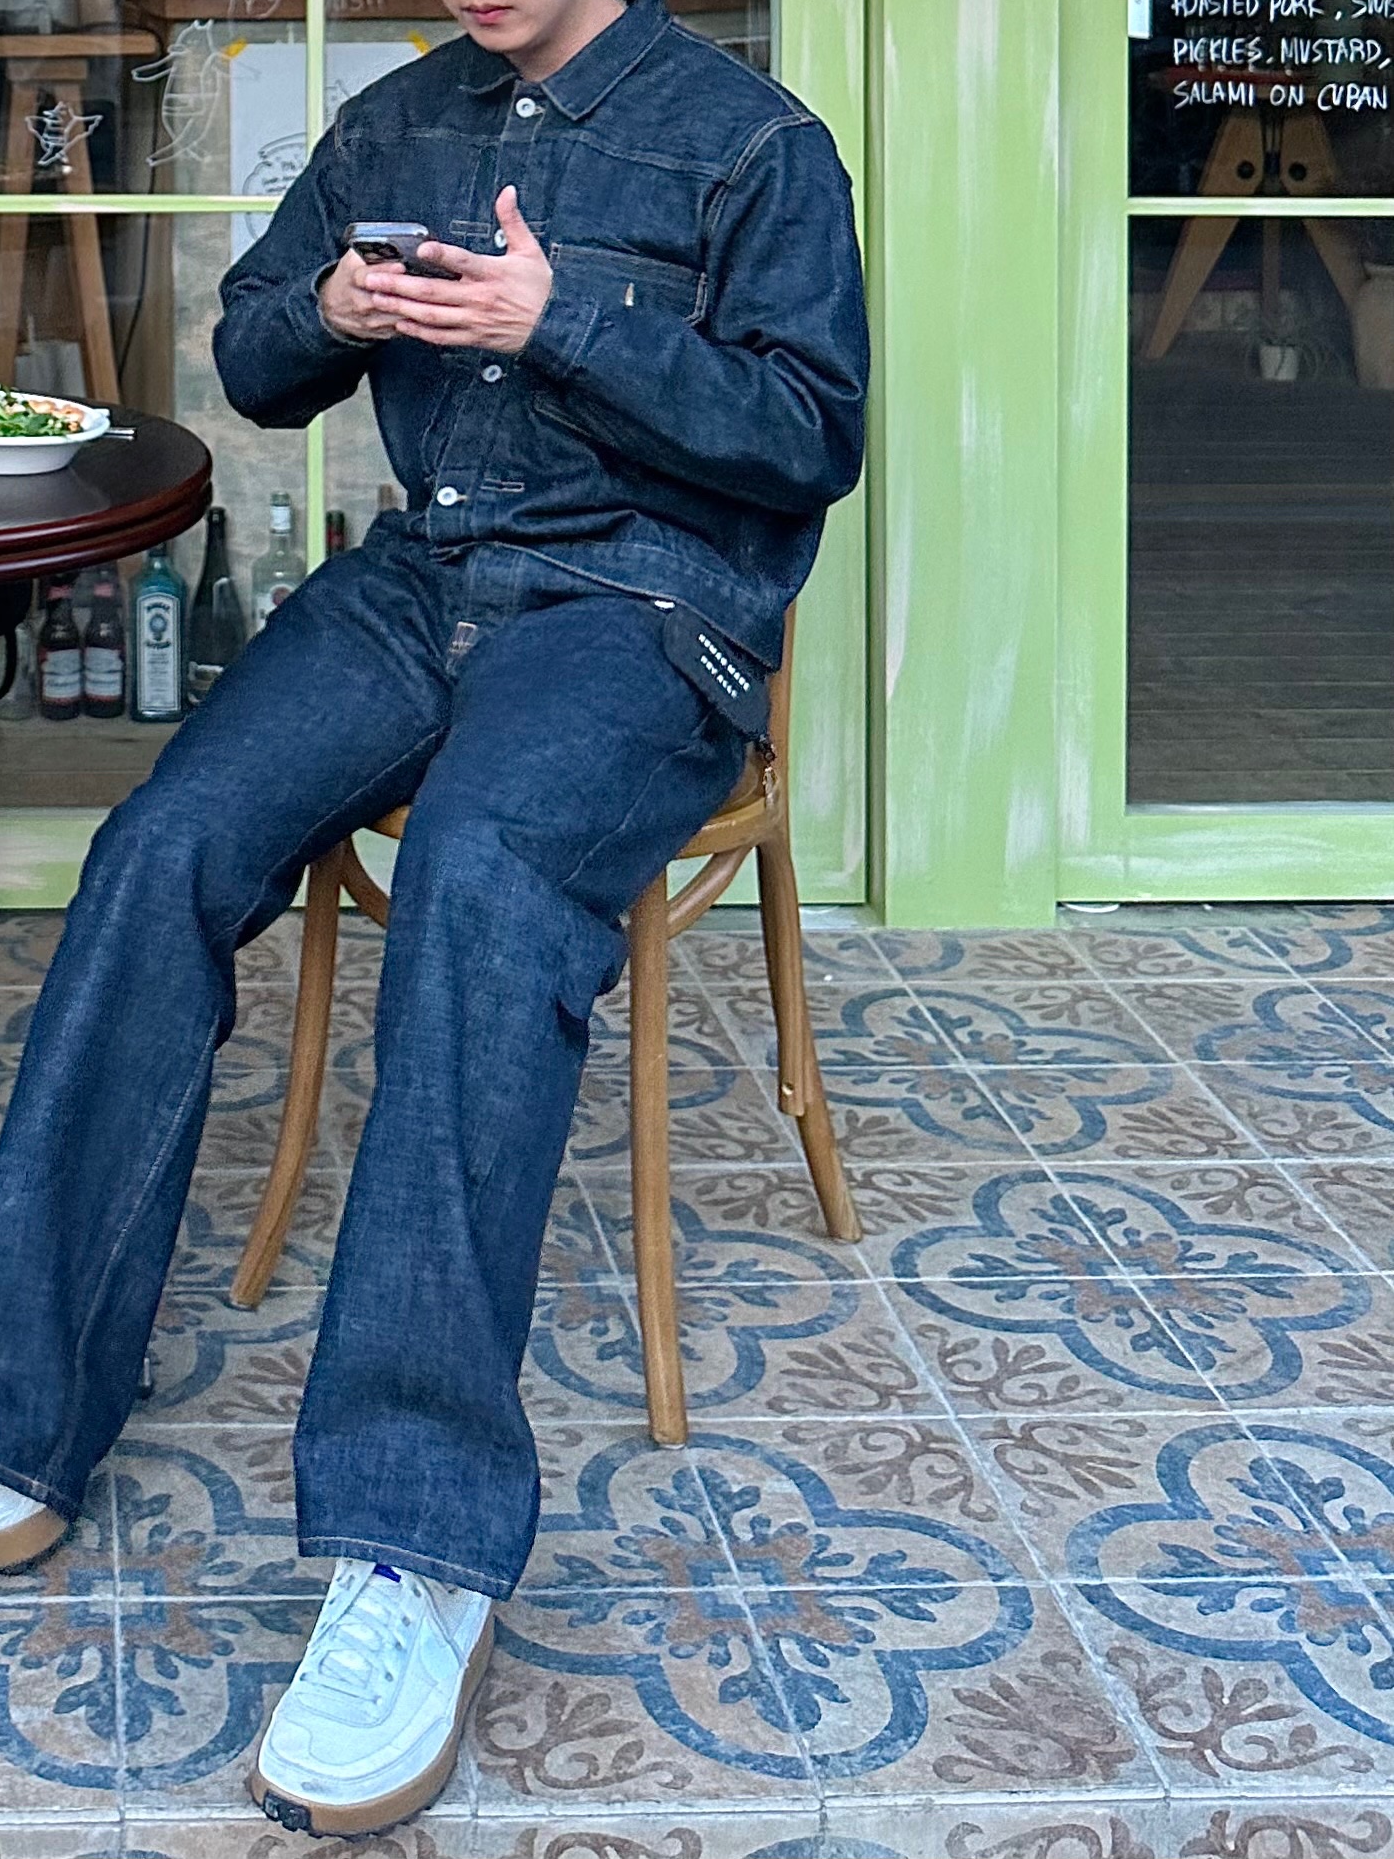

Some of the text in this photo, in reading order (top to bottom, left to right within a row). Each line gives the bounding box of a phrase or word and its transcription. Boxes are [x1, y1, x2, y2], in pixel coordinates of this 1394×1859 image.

[1173, 80, 1388, 112] SALAMI ON CUBAN
